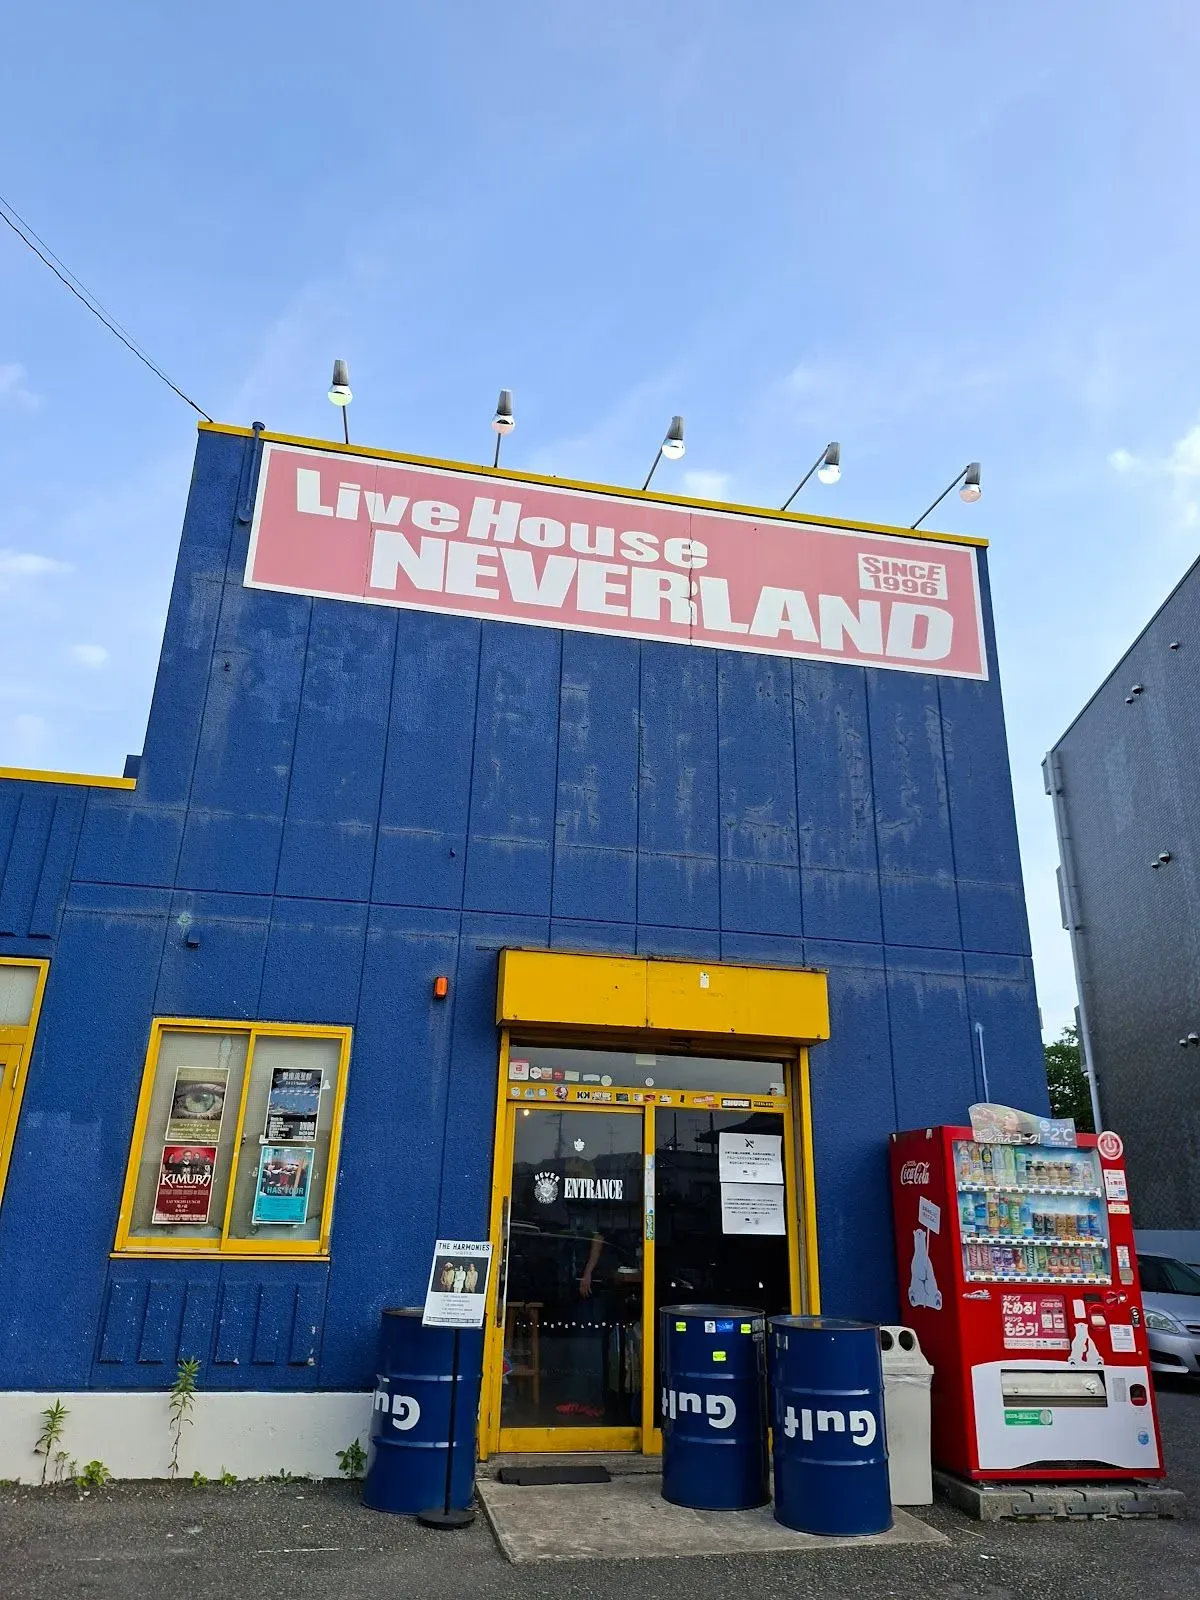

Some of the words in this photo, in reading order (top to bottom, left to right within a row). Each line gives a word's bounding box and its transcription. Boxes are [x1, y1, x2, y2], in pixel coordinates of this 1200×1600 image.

[863, 556, 941, 582] SINCE
[369, 528, 954, 662] NEVERLAND
[870, 575, 938, 596] 1996
[534, 1171, 560, 1183] NEVER
[563, 1177, 623, 1200] ENTRANCE
[439, 1242, 451, 1250] THE
[452, 1243, 490, 1251] HARMONIES
[1002, 1301, 1037, 1315] ためる!
[1004, 1322, 1039, 1336] もらう!
[662, 1387, 737, 1429] Gulf
[784, 1405, 876, 1447] Gulf
